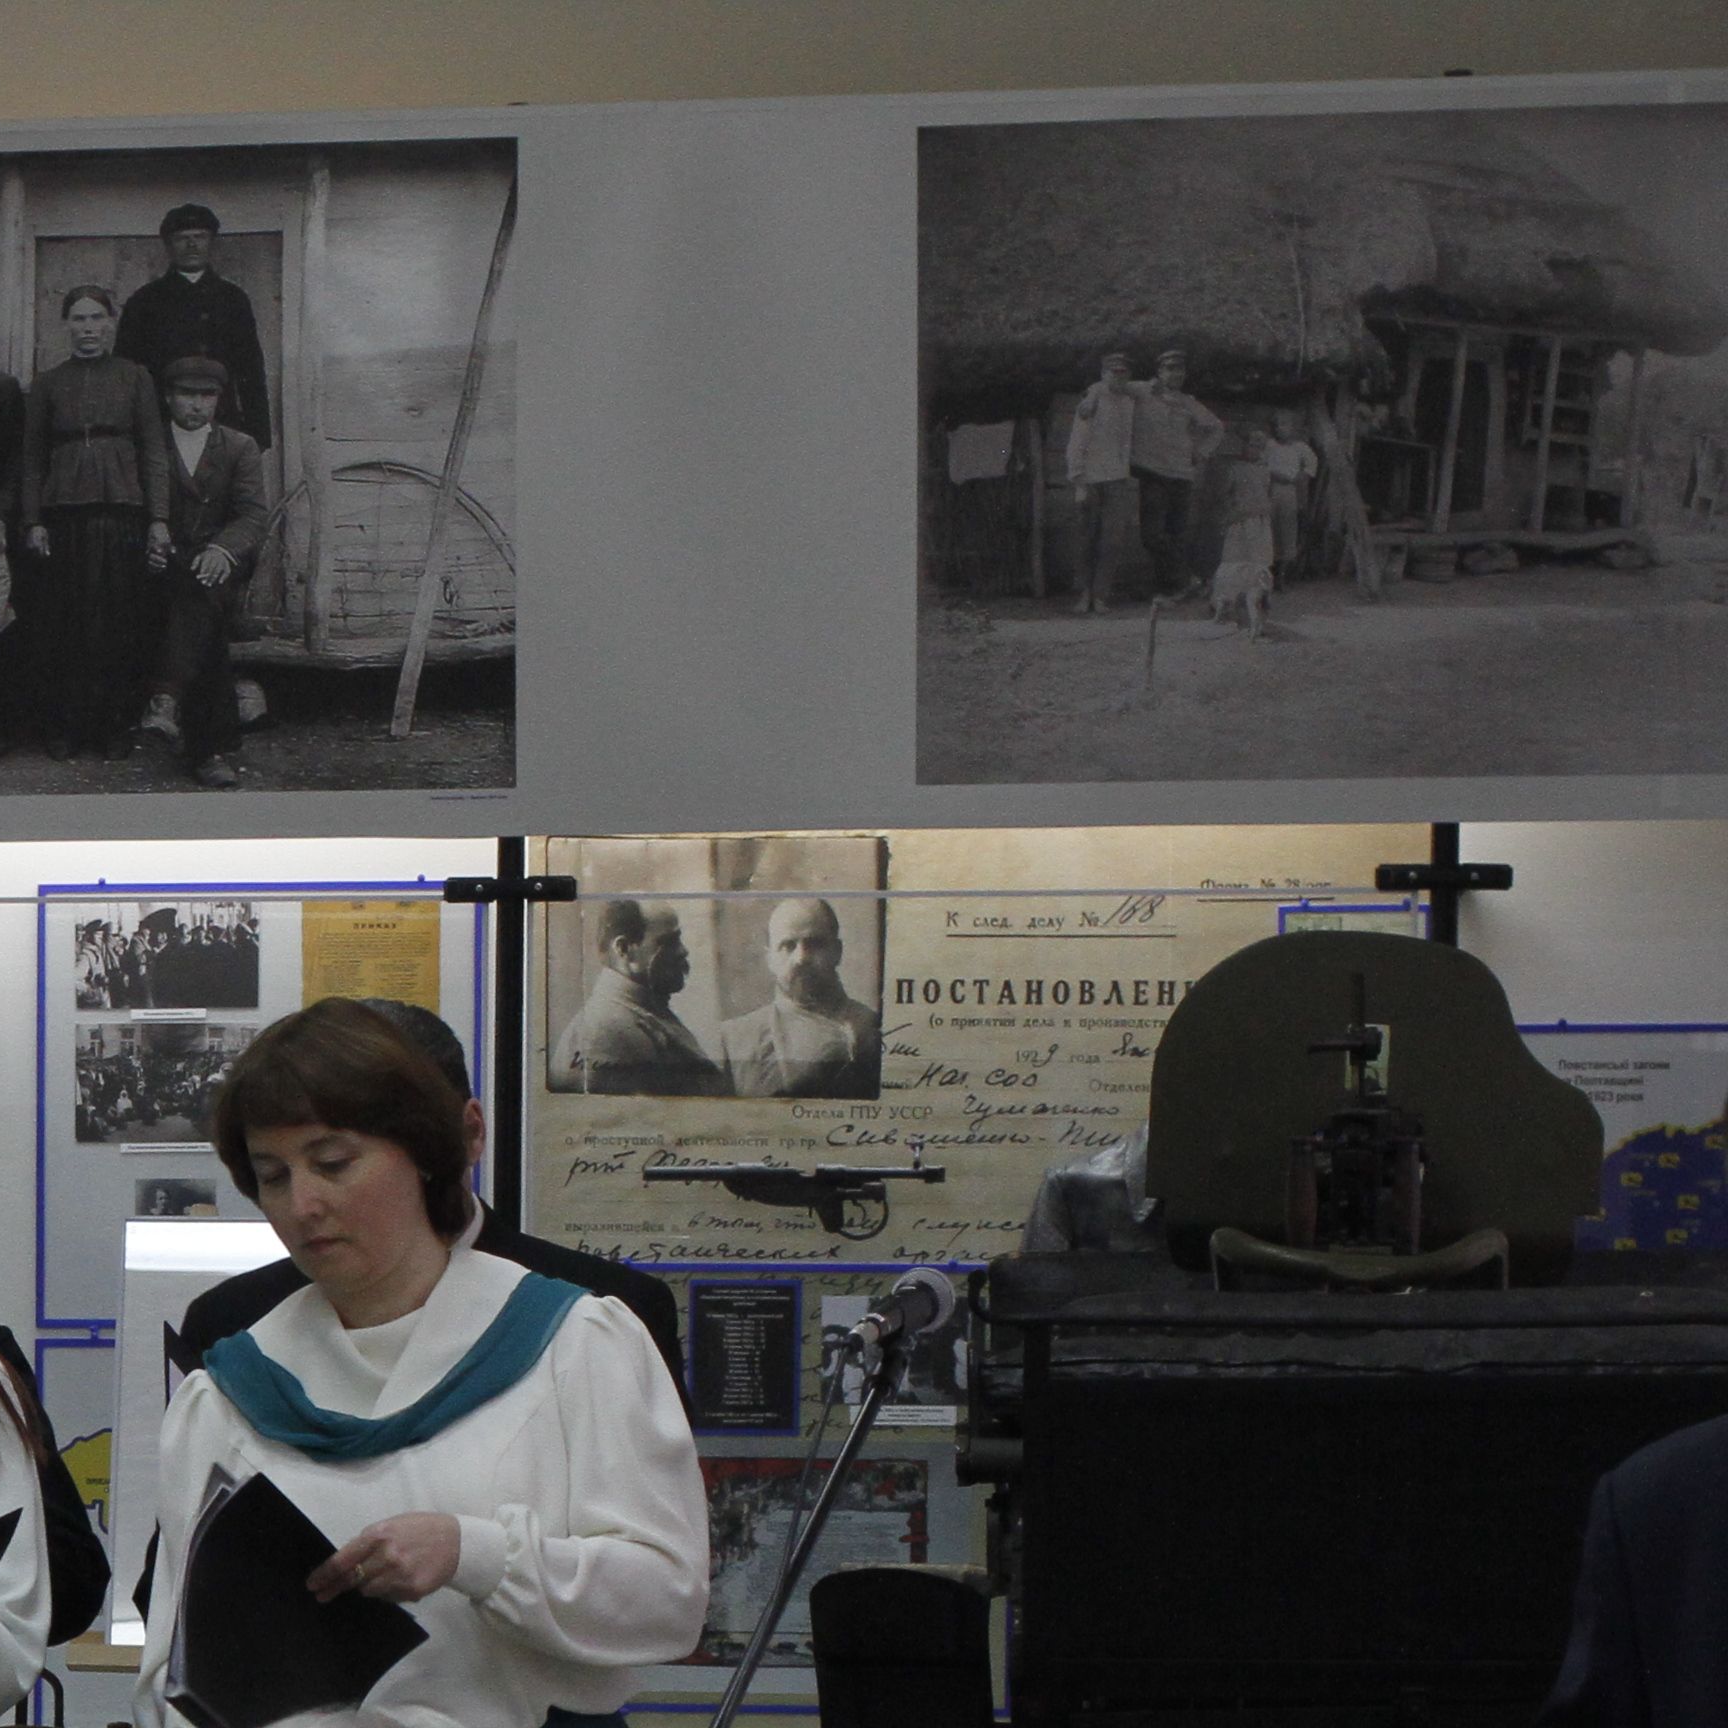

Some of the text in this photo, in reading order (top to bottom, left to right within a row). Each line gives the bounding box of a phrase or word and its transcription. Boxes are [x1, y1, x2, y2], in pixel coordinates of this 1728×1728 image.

[945, 911, 959, 928] К
[973, 914, 1014, 928] след.
[1027, 914, 1065, 930] делу
[849, 1105, 882, 1120] ГПУ
[888, 1105, 933, 1120] УССР
